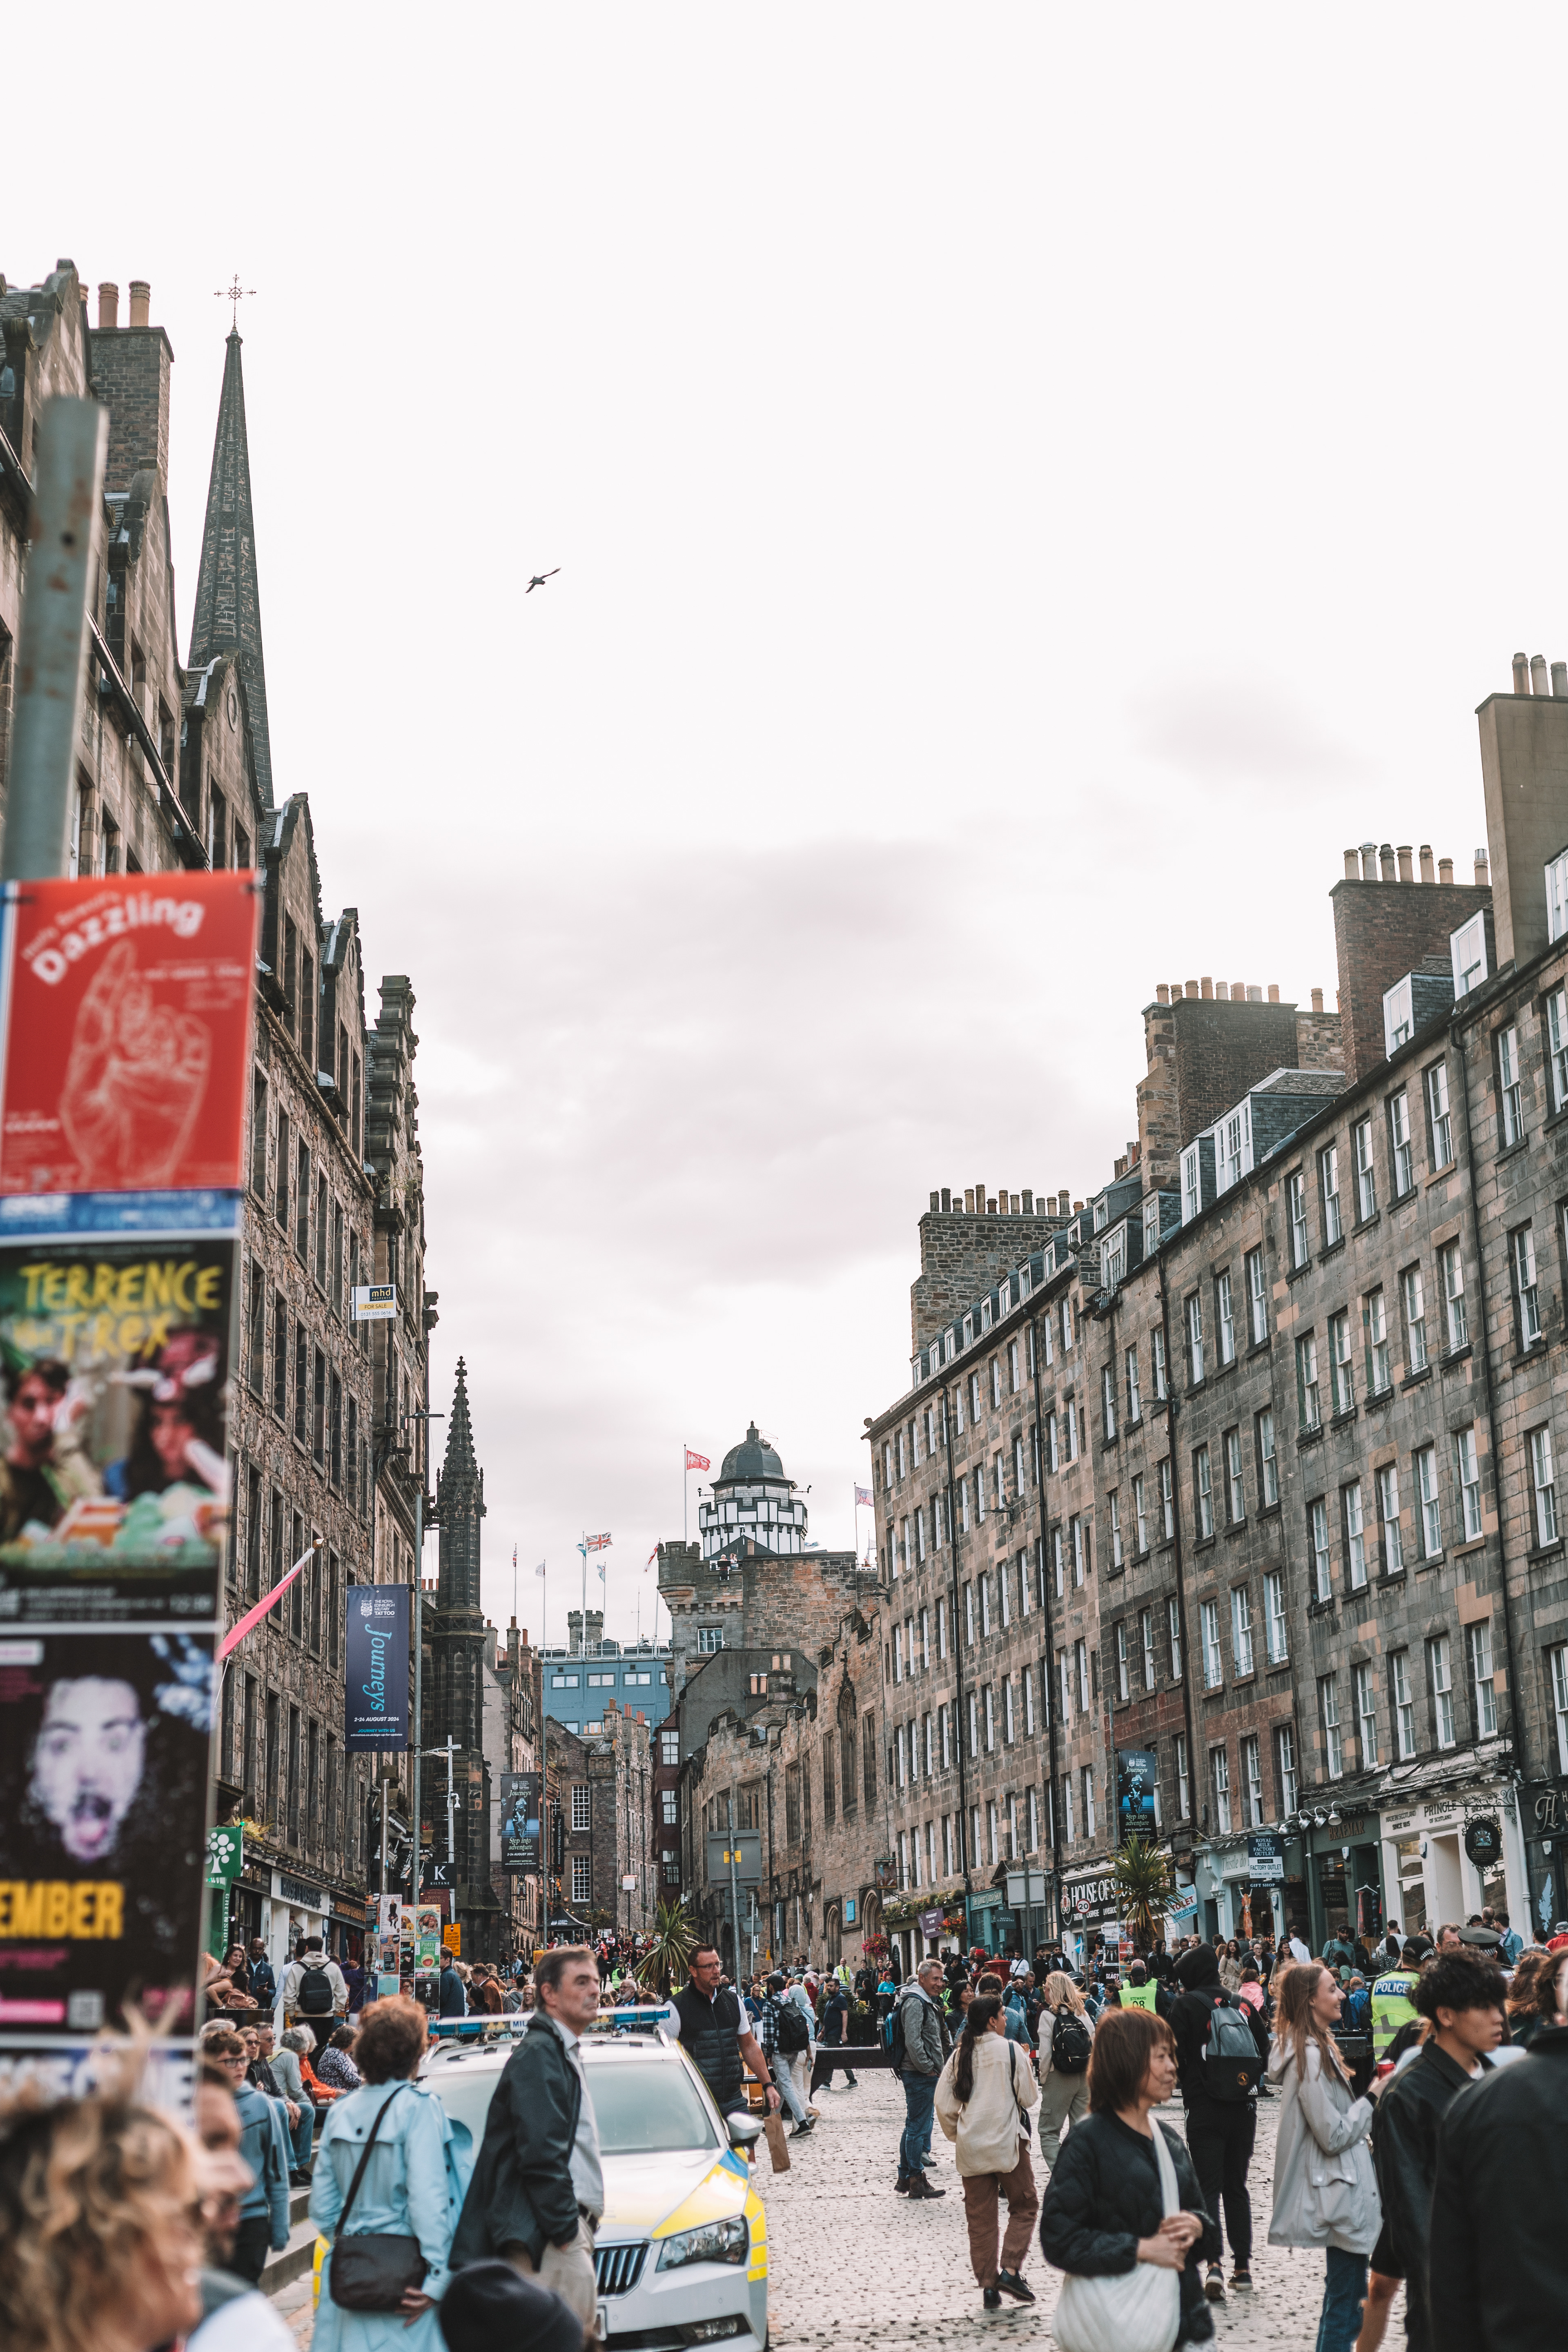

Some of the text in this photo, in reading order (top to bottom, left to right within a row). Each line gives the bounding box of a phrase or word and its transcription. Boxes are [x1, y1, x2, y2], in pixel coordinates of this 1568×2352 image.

[31, 895, 205, 984] Dazzling
[19, 1260, 223, 1314] TERRENCE
[372, 1287, 391, 1297] mhd
[362, 1624, 392, 1712] Journeys
[1125, 1766, 1148, 1775] Journeys
[1424, 1800, 1457, 1817] PRINGLE
[1434, 1814, 1452, 1822] SCOTLAND
[1328, 1820, 1364, 1840] BRAEMAR
[1222, 1853, 1246, 1871] Thistle do
[434, 1866, 446, 1880] K
[1071, 1882, 1097, 1907] HOUSE
[1098, 1879, 1109, 1901] OF
[1180, 1896, 1194, 1908] LET
[1375, 1982, 1410, 1993] POLICE
[1133, 2000, 1145, 2009] 08
